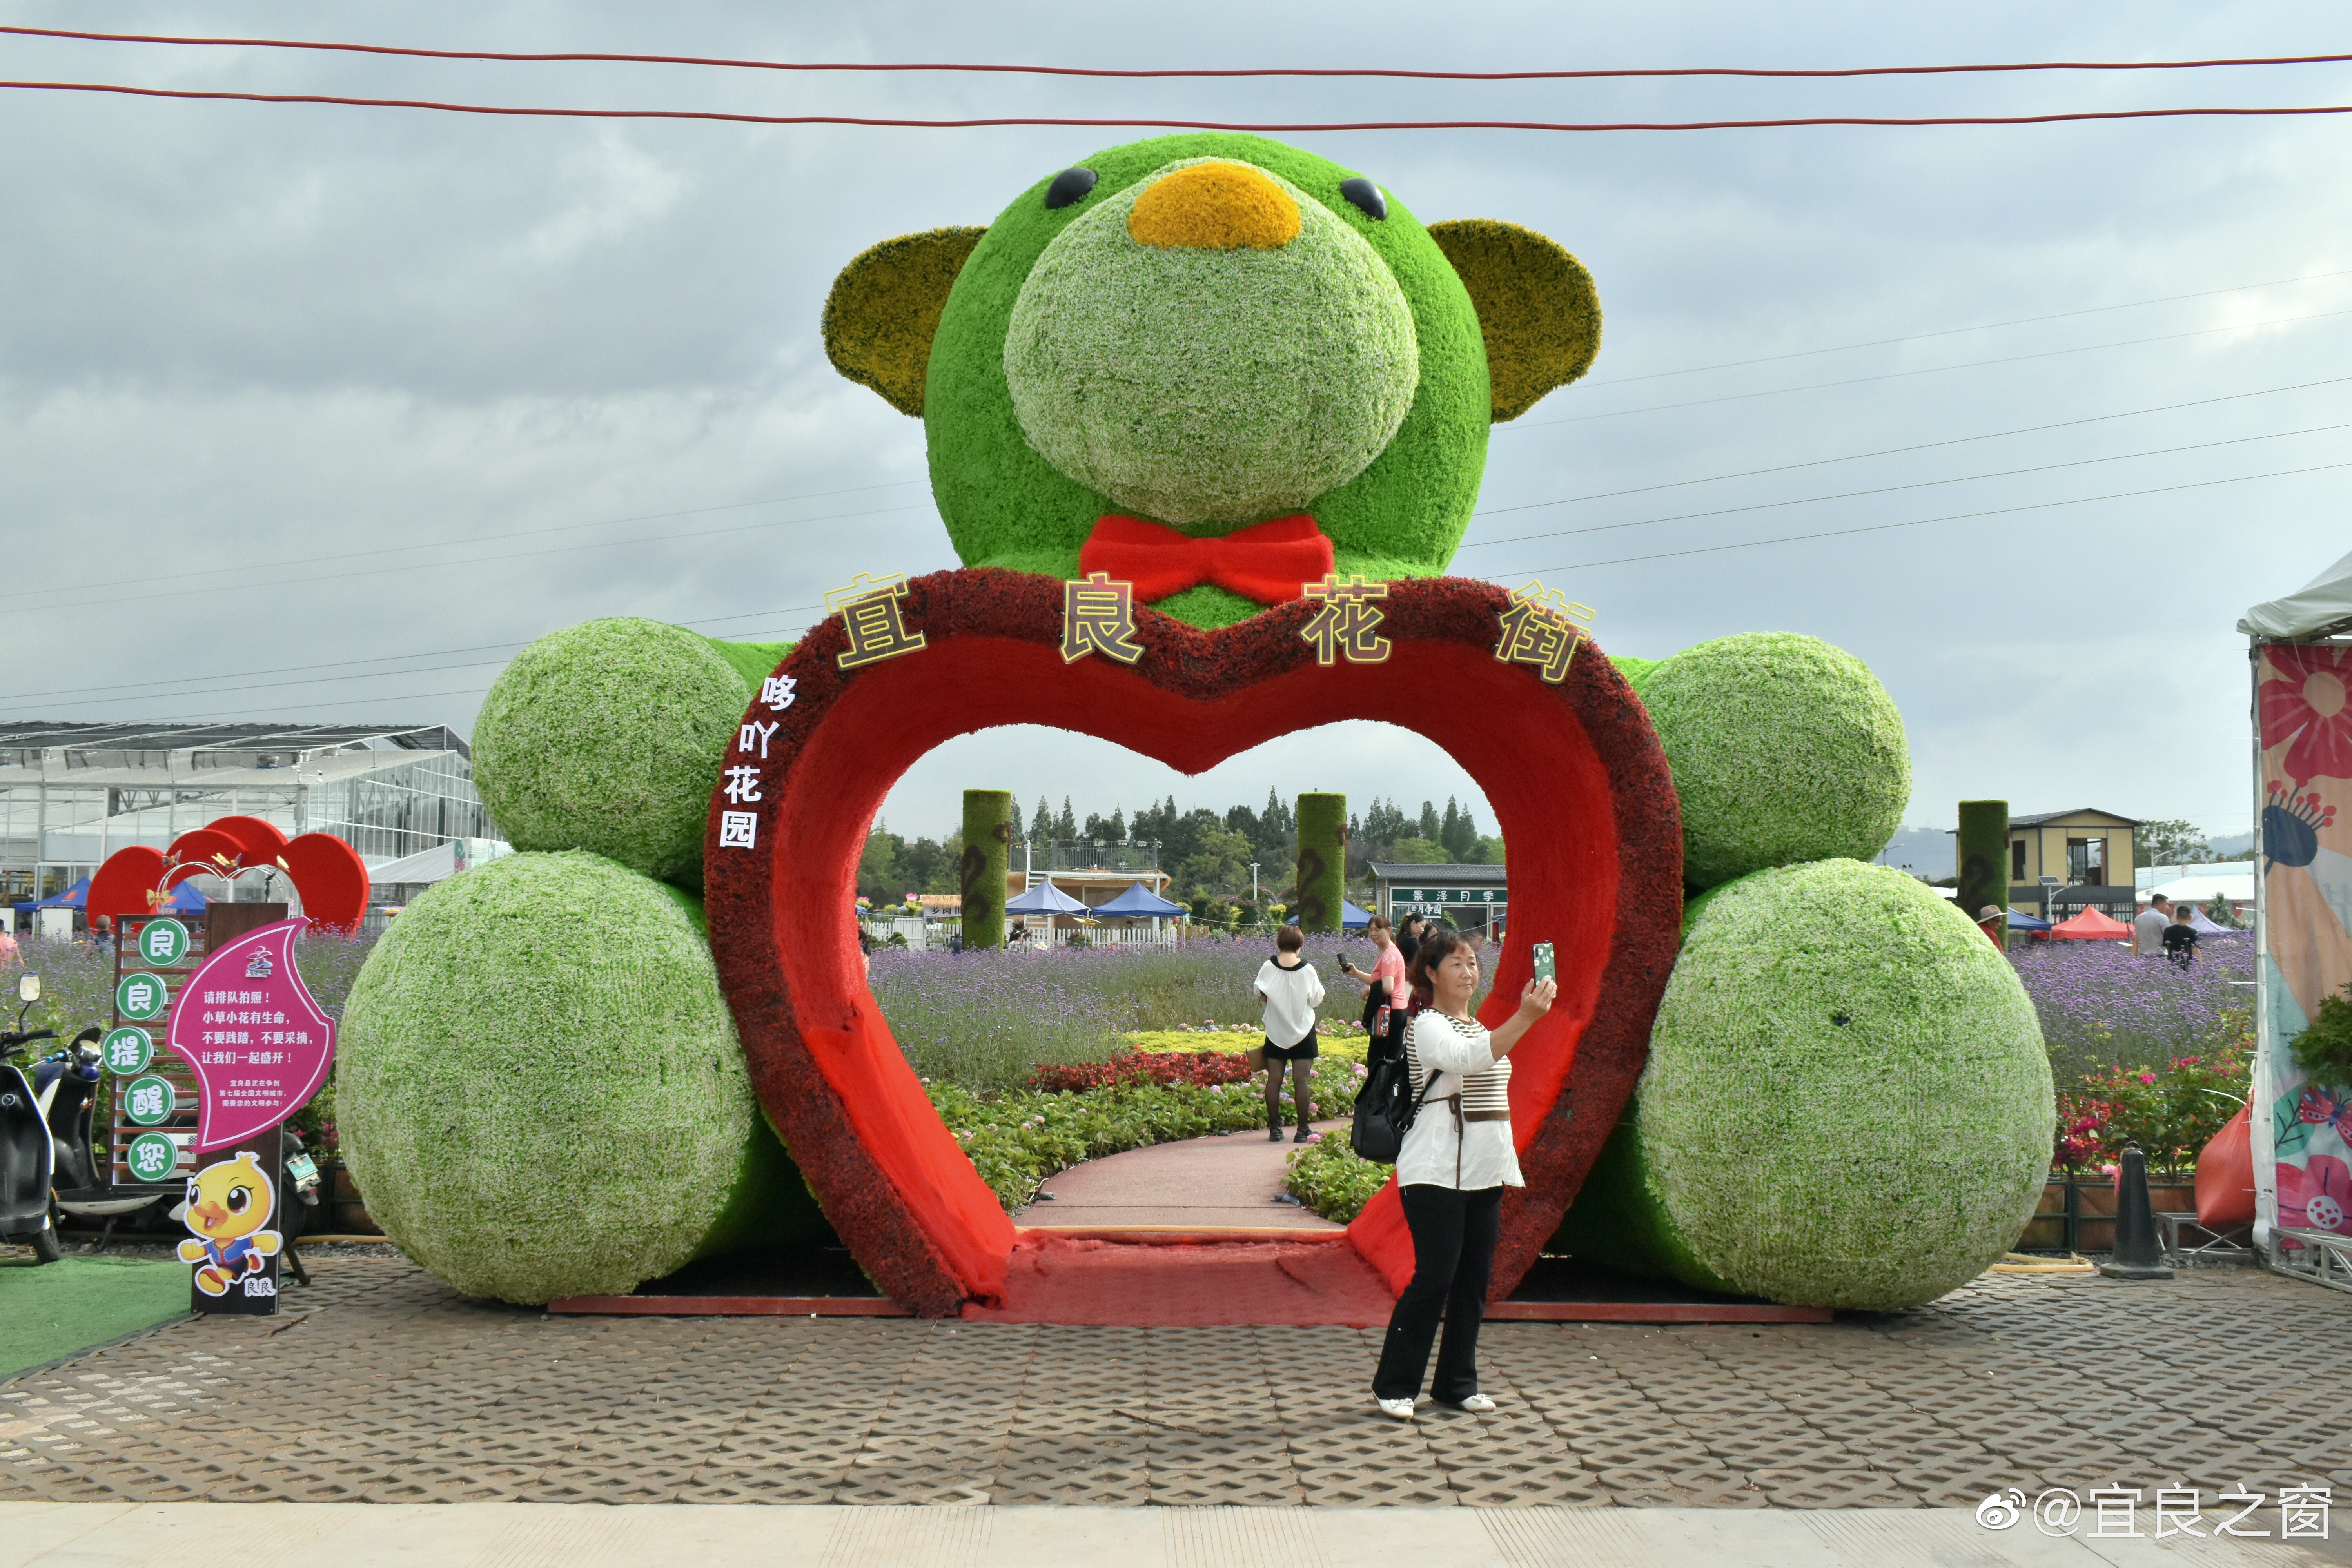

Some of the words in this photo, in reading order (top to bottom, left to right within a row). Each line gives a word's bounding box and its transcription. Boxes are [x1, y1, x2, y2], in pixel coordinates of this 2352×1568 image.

[824, 572, 1595, 682] 宜良花街
[720, 674, 798, 849] 哆吖花园
[204, 991, 269, 1004] 请排队拍照！
[203, 1011, 290, 1024] 小草小花有生命，
[111, 928, 174, 1172] 良良提醒您
[201, 1051, 292, 1064] 让我们一起盛开！
[247, 1281, 272, 1294] 良良
